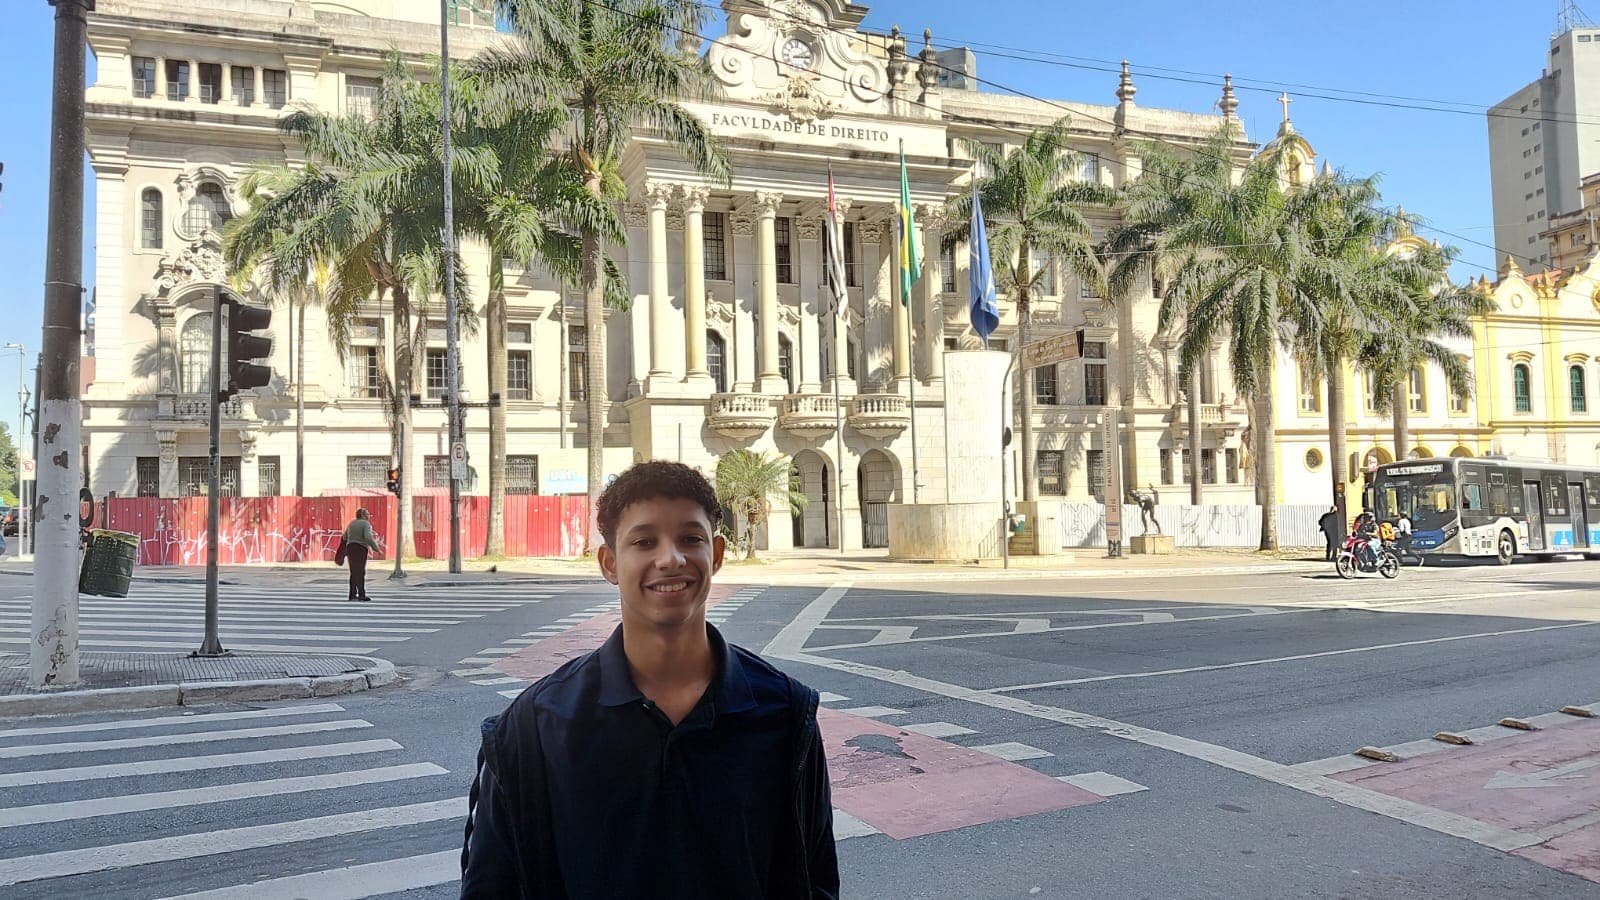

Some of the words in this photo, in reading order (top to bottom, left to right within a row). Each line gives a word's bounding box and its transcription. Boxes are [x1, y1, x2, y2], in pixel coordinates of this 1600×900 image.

[712, 113, 802, 134] FACVLDADE
[807, 124, 826, 136] DE
[830, 126, 889, 142] DIREITO
